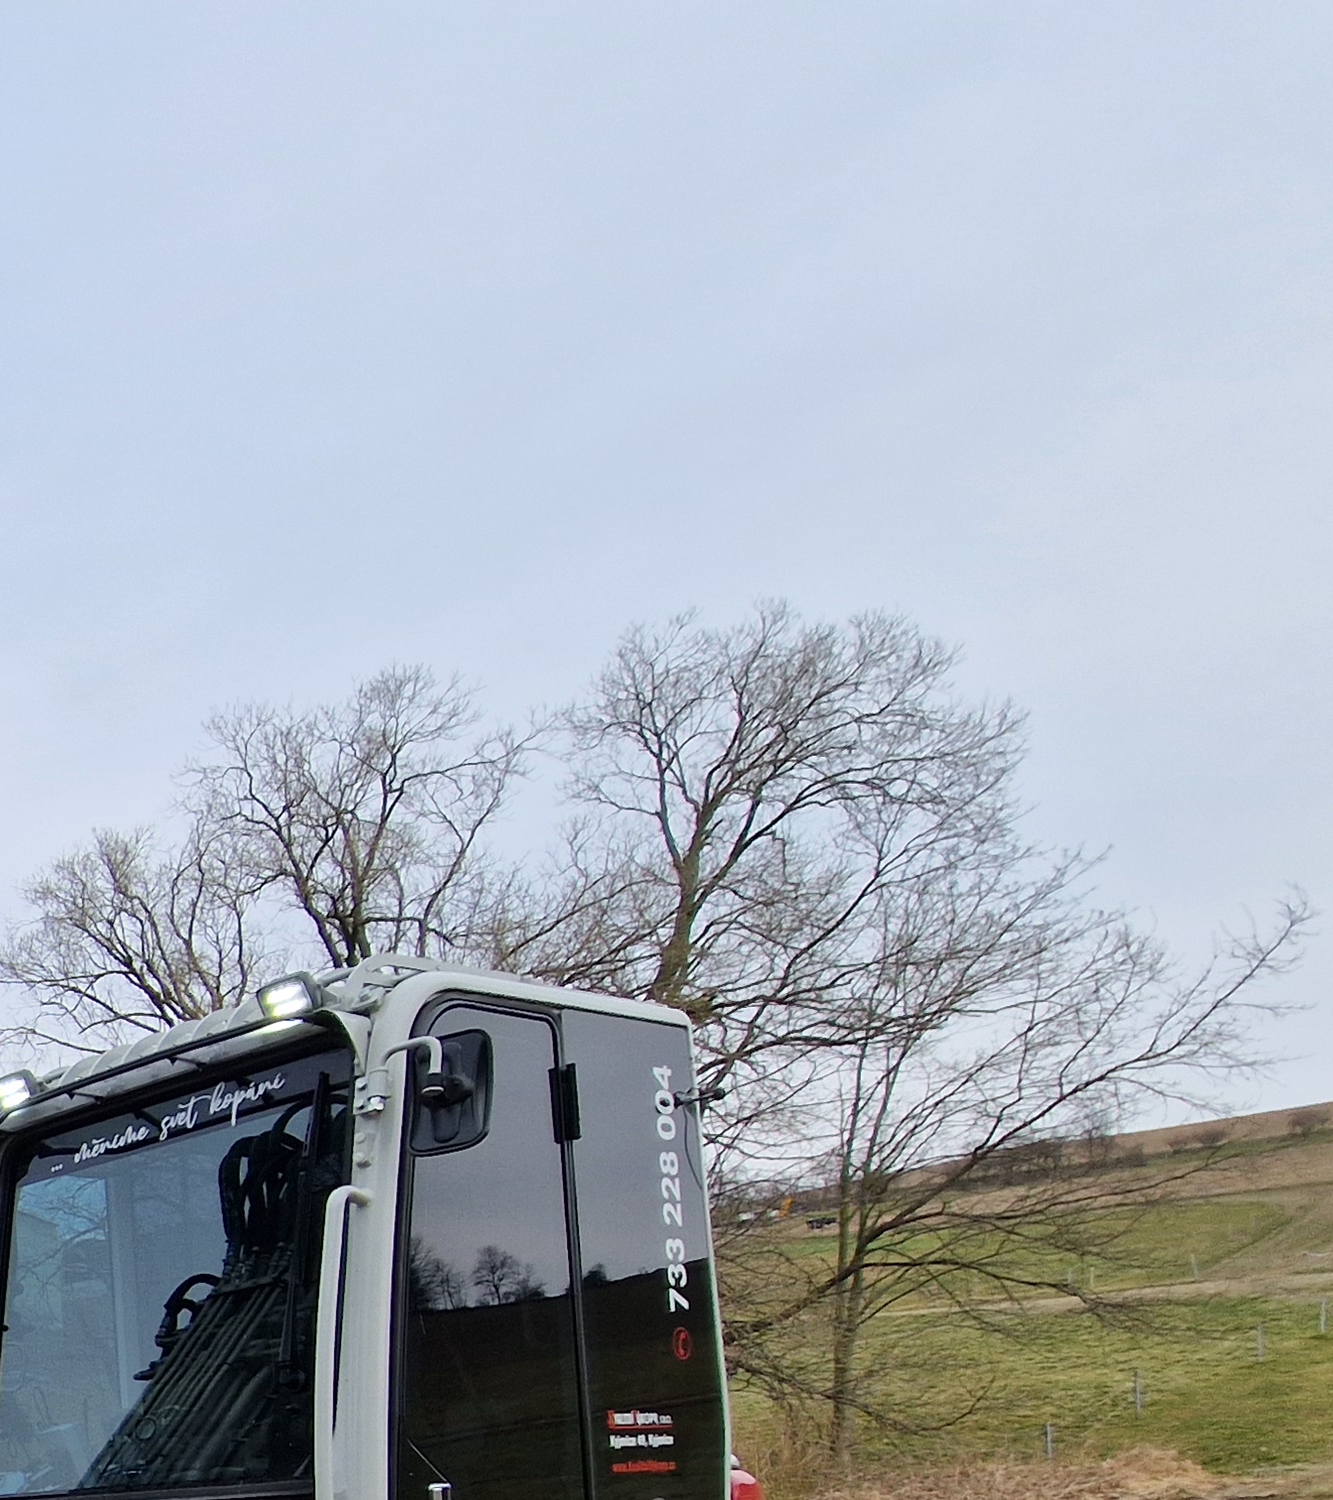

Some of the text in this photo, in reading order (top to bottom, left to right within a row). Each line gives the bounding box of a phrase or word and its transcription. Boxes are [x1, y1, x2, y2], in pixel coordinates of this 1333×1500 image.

[209, 1072, 286, 1127] kopání
[652, 1065, 690, 1313] 733 228 004
